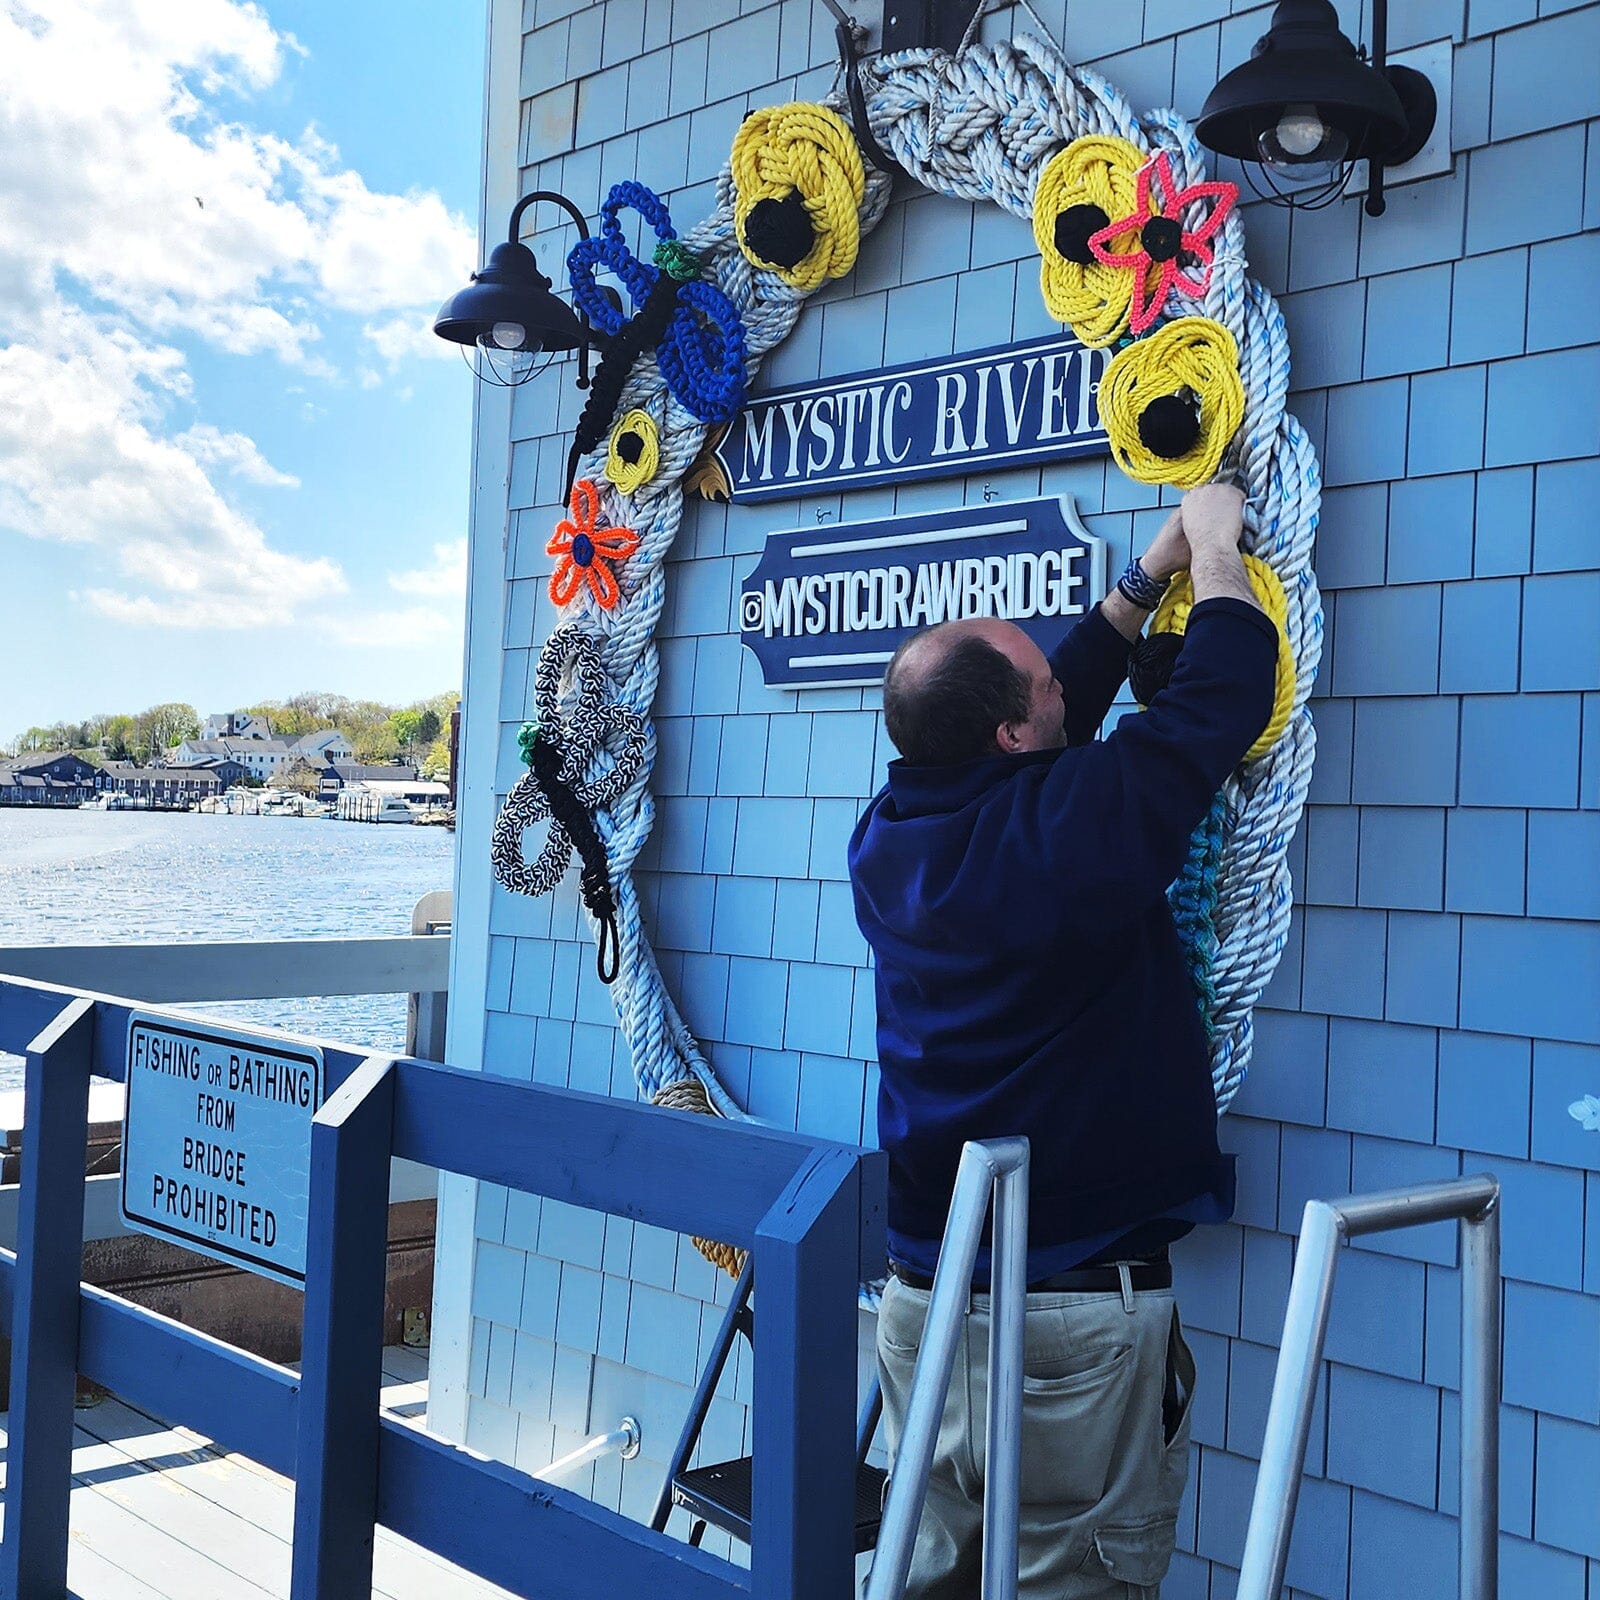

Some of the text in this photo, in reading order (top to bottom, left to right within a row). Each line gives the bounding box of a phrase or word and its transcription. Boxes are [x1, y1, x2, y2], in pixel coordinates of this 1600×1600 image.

[738, 346, 1113, 484] MYSTIC RIVER
[764, 546, 1085, 639] MYSTICDRAWBRIDGE
[135, 1034, 310, 1108] FISHING OR BATHING
[197, 1093, 235, 1132] FROM
[183, 1137, 246, 1187] BRIDGE
[153, 1174, 276, 1247] PROHIBITED
